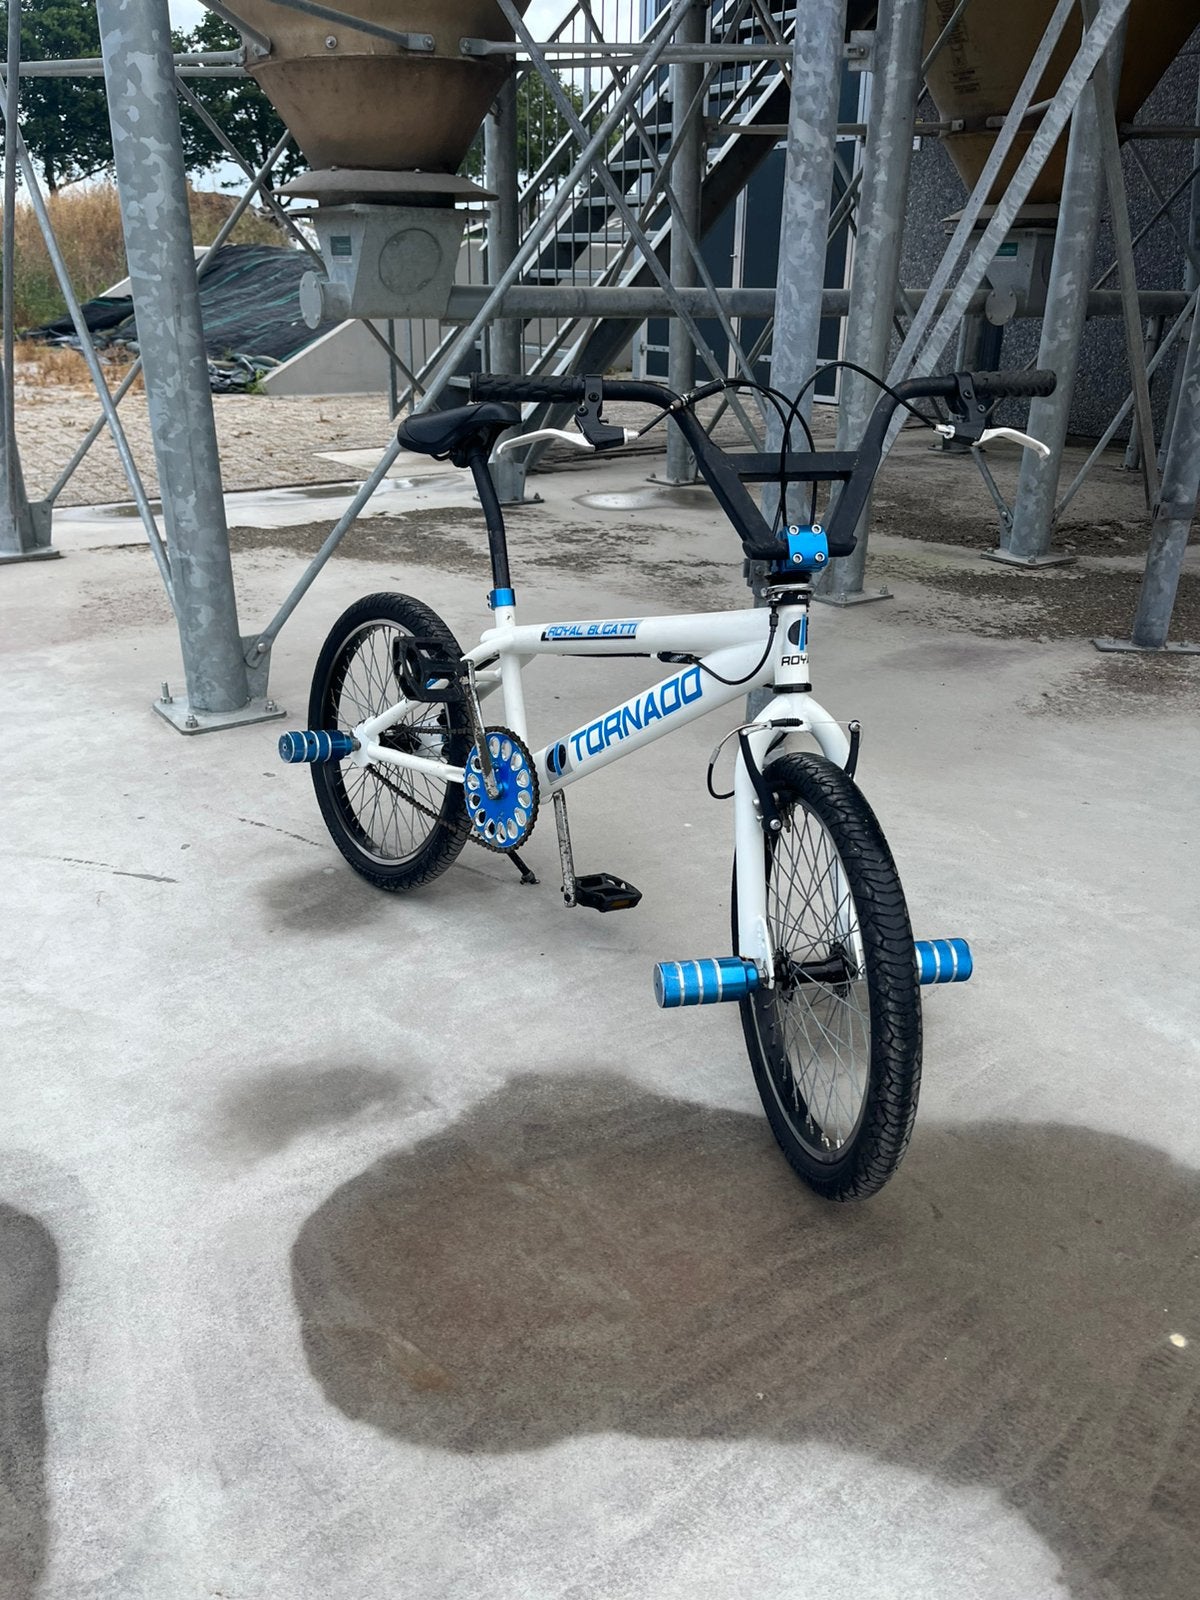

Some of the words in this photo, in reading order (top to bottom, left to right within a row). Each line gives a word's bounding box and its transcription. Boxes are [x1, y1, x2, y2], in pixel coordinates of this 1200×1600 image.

[547, 625, 583, 637] ROYAL
[781, 655, 809, 666] ROY
[569, 665, 704, 761] TORNADO
